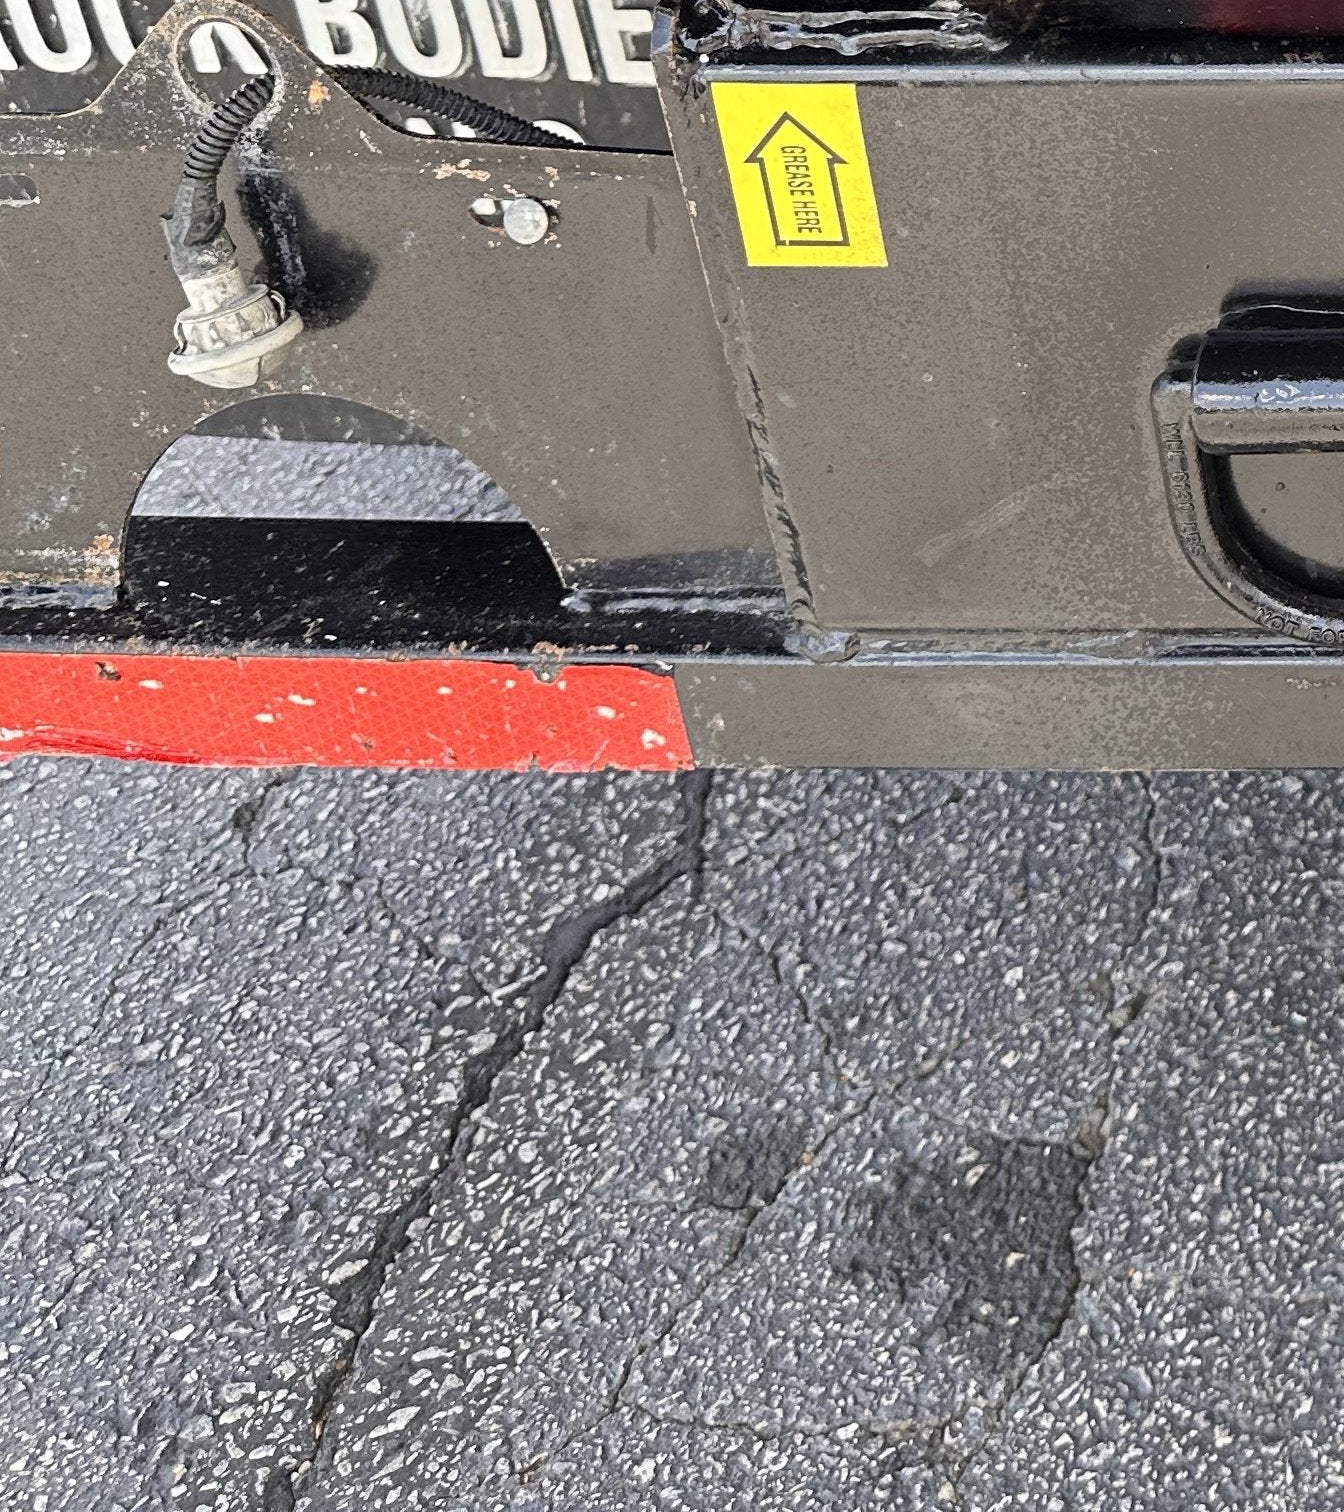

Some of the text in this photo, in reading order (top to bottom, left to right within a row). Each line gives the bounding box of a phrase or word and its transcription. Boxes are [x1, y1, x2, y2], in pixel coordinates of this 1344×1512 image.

[781, 145, 822, 234] GREASE HERE
[1254, 606, 1301, 635] NOT
